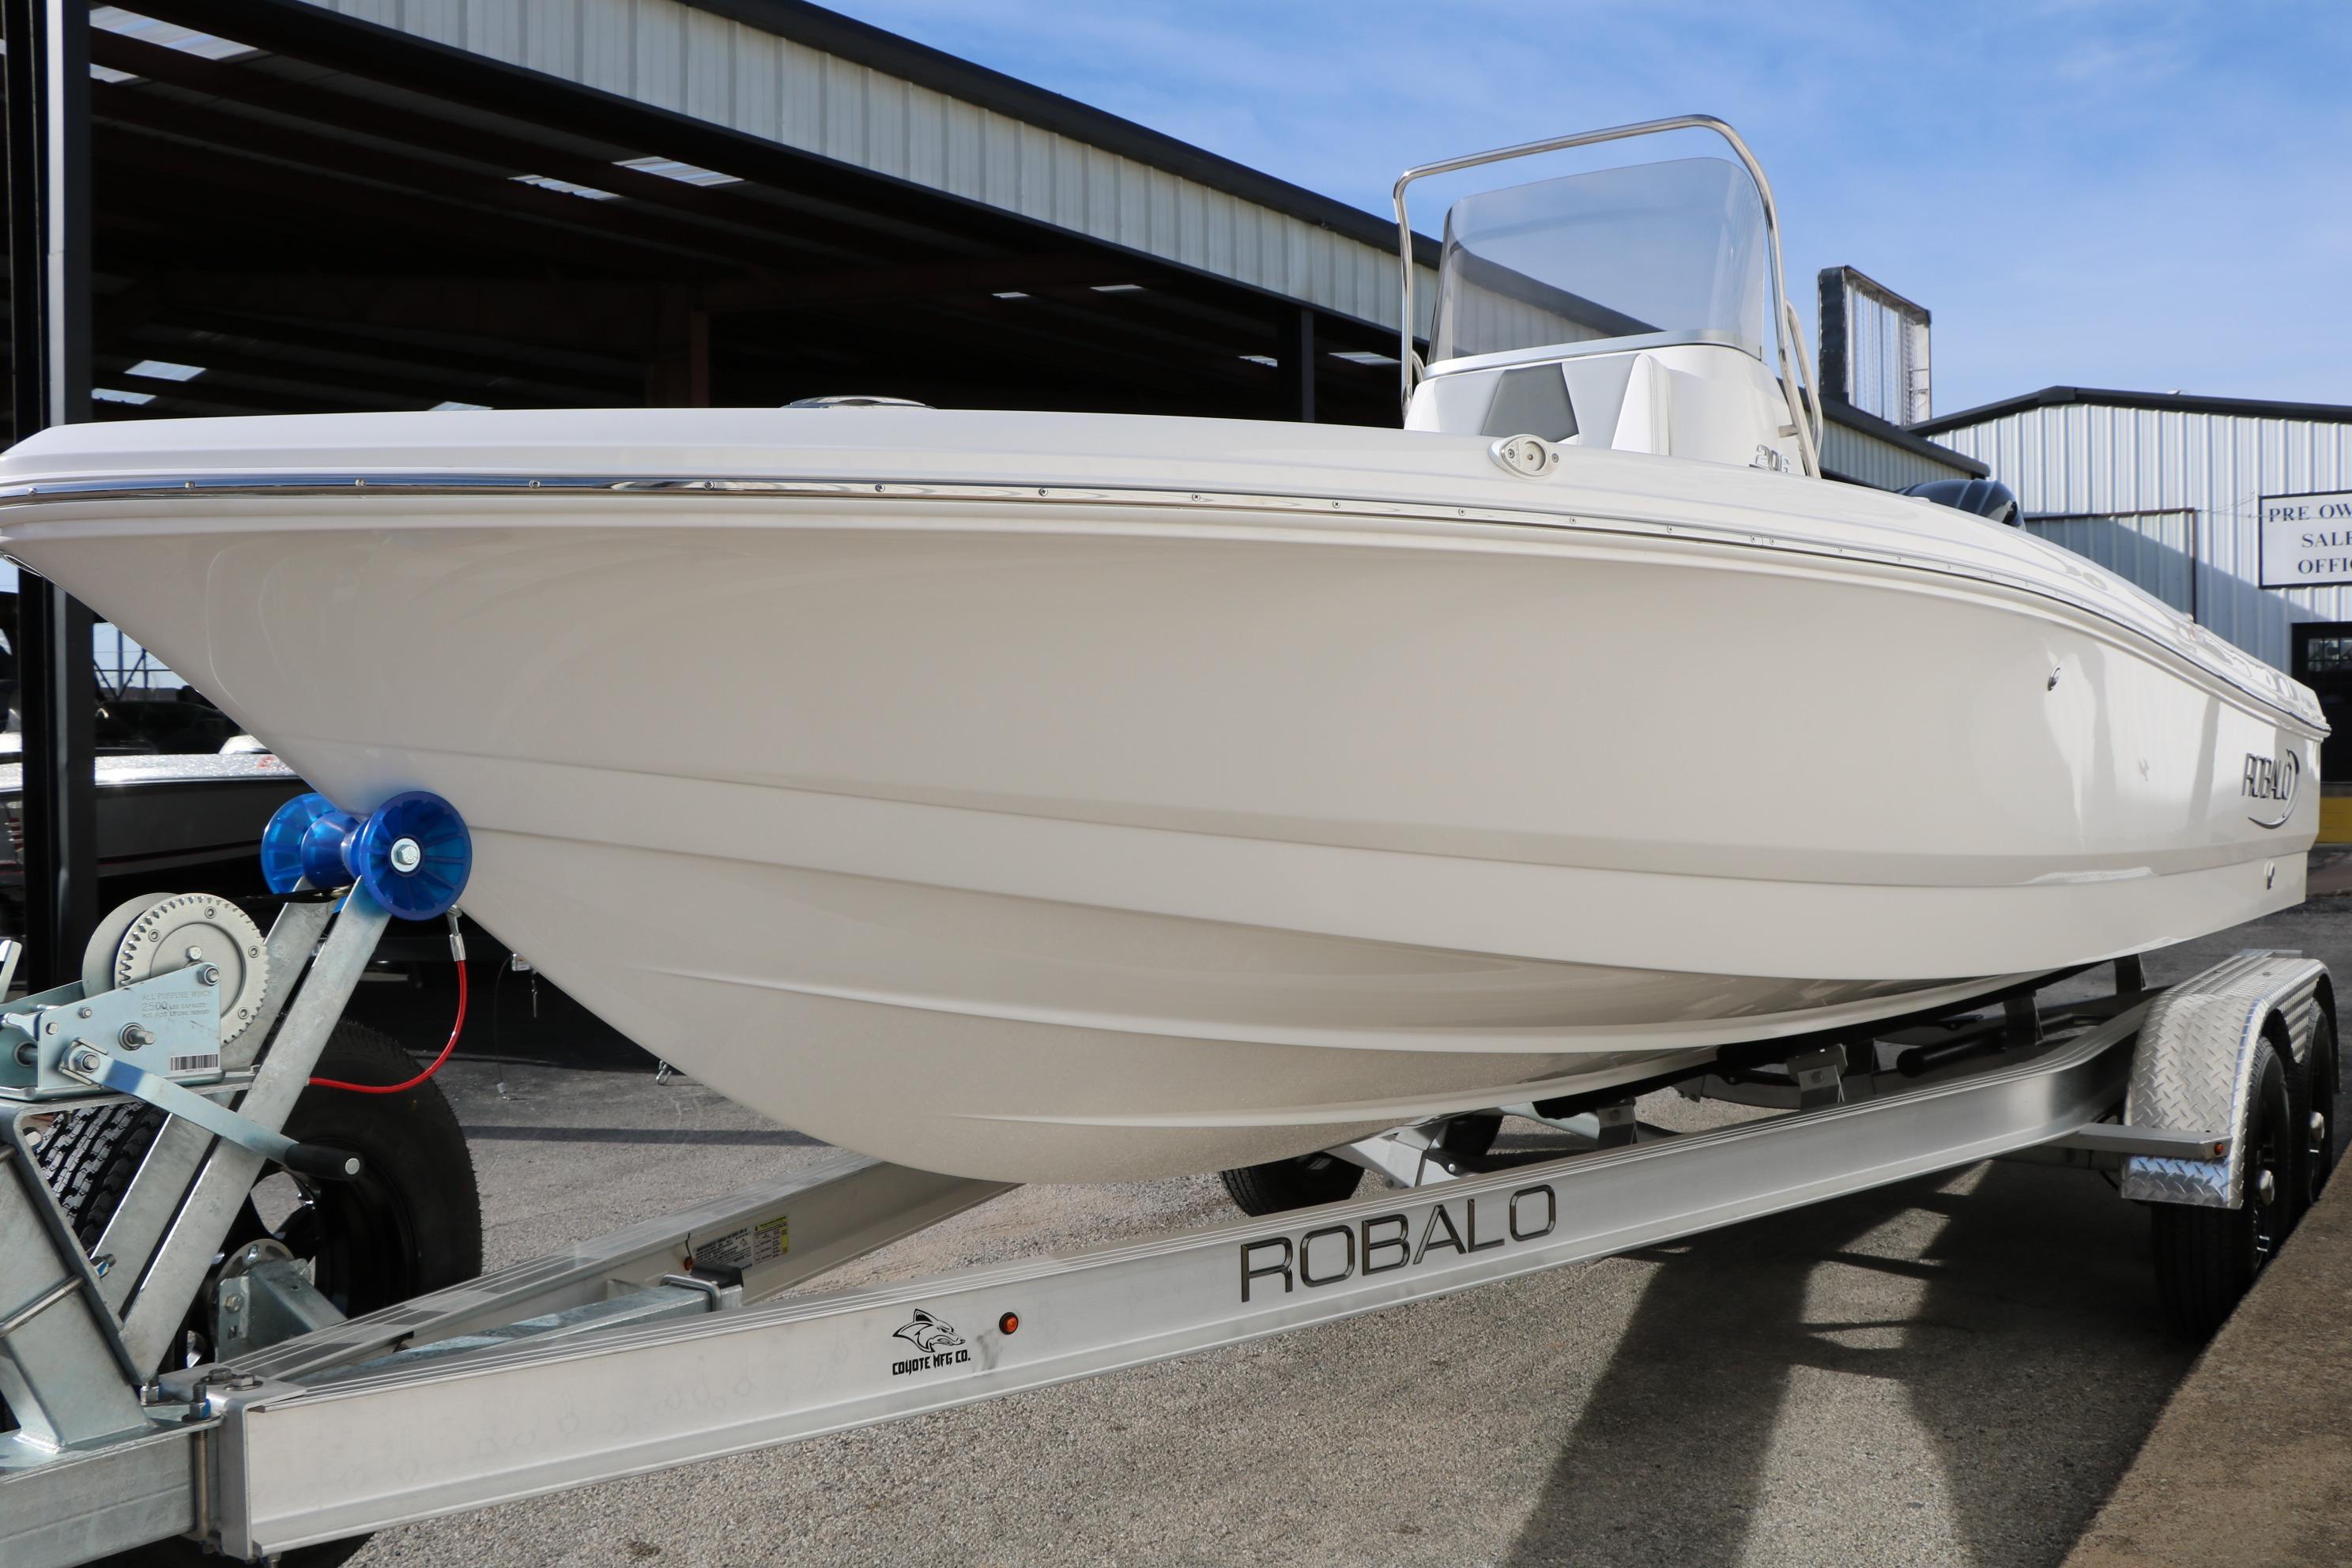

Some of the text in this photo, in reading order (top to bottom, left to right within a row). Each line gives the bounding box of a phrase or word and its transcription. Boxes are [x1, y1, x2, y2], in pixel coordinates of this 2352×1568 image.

[2269, 506, 2309, 522] PRE
[2297, 557, 2352, 575] OFFI
[2241, 752, 2292, 801] ROBALO
[141, 1001, 168, 1011] 2500
[1241, 1184, 1556, 1302] ROBALO
[892, 1349, 971, 1376] COYOTE MFG CO.
